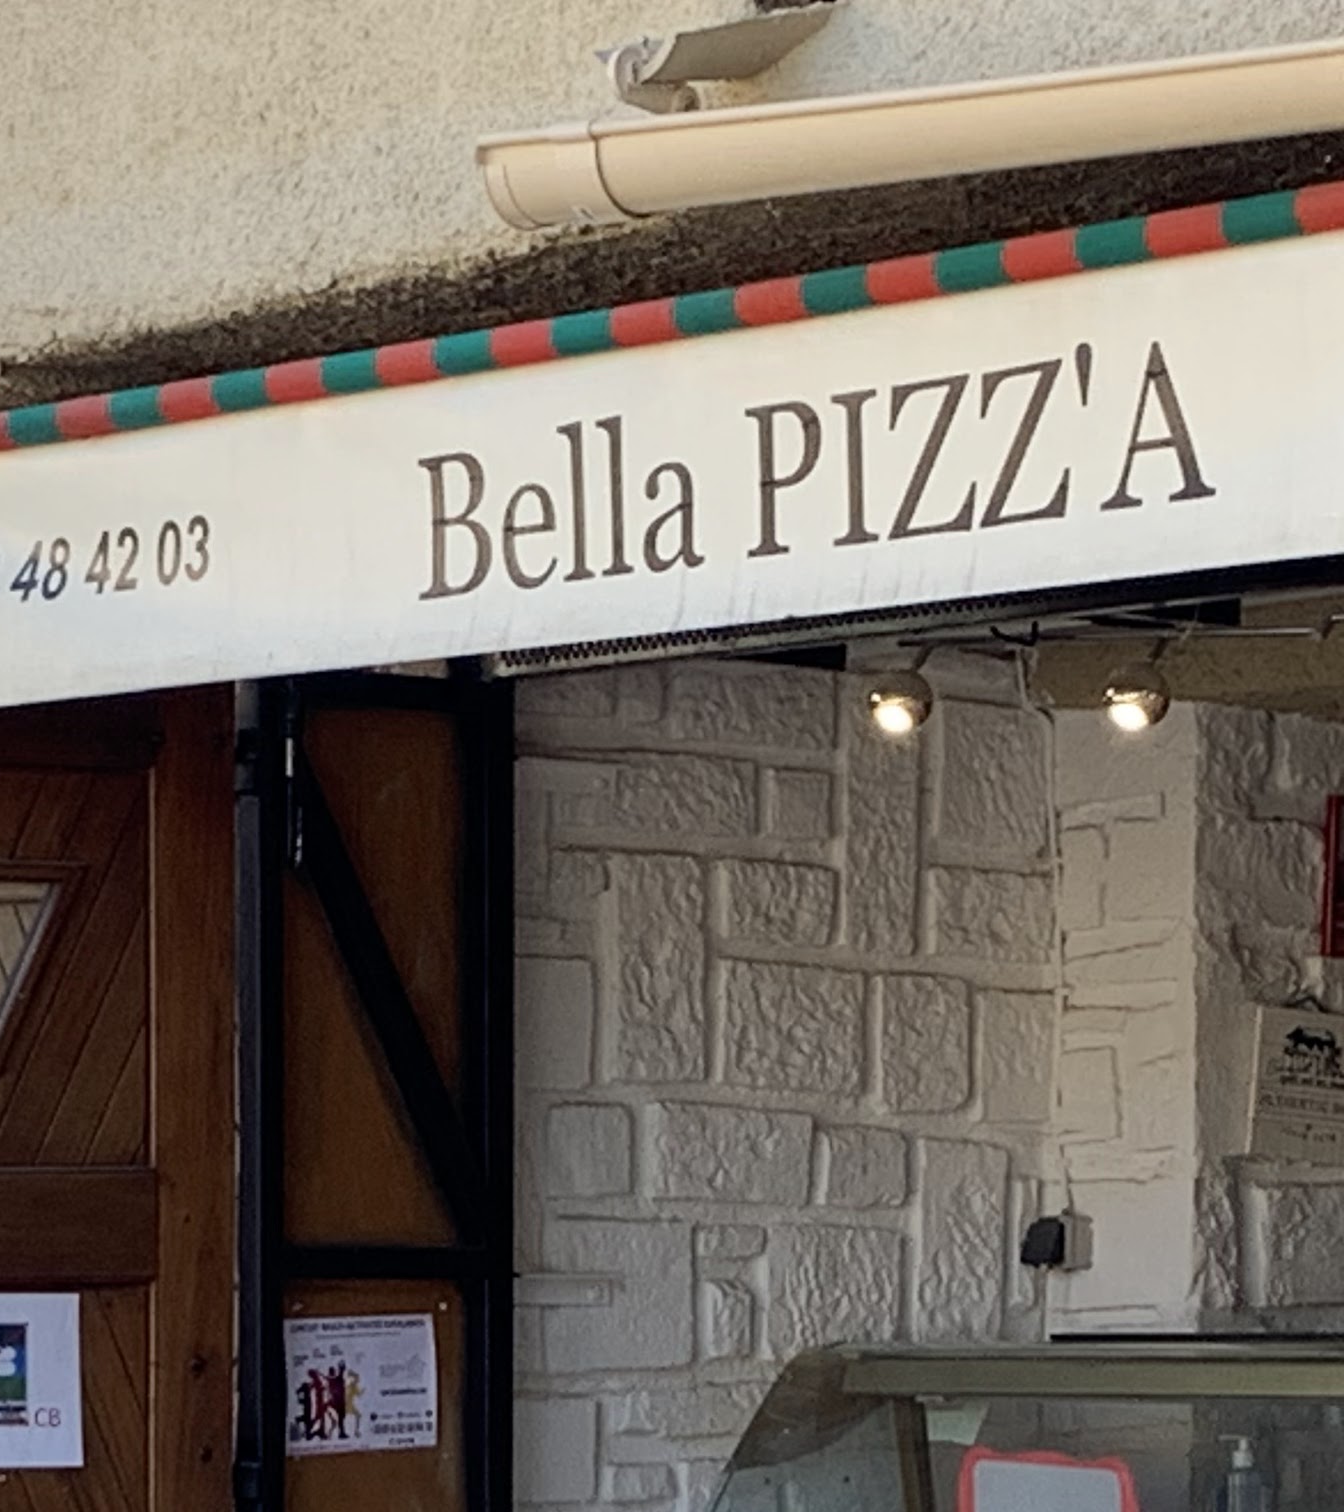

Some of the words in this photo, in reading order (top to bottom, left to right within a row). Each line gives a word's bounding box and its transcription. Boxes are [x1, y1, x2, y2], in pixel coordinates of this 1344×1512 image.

[418, 415, 704, 602] Bella
[744, 340, 1216, 558] PIZZ'A
[10, 537, 70, 603] 48
[85, 527, 139, 595] 42
[157, 515, 211, 586] 03
[34, 1407, 61, 1427] CB
